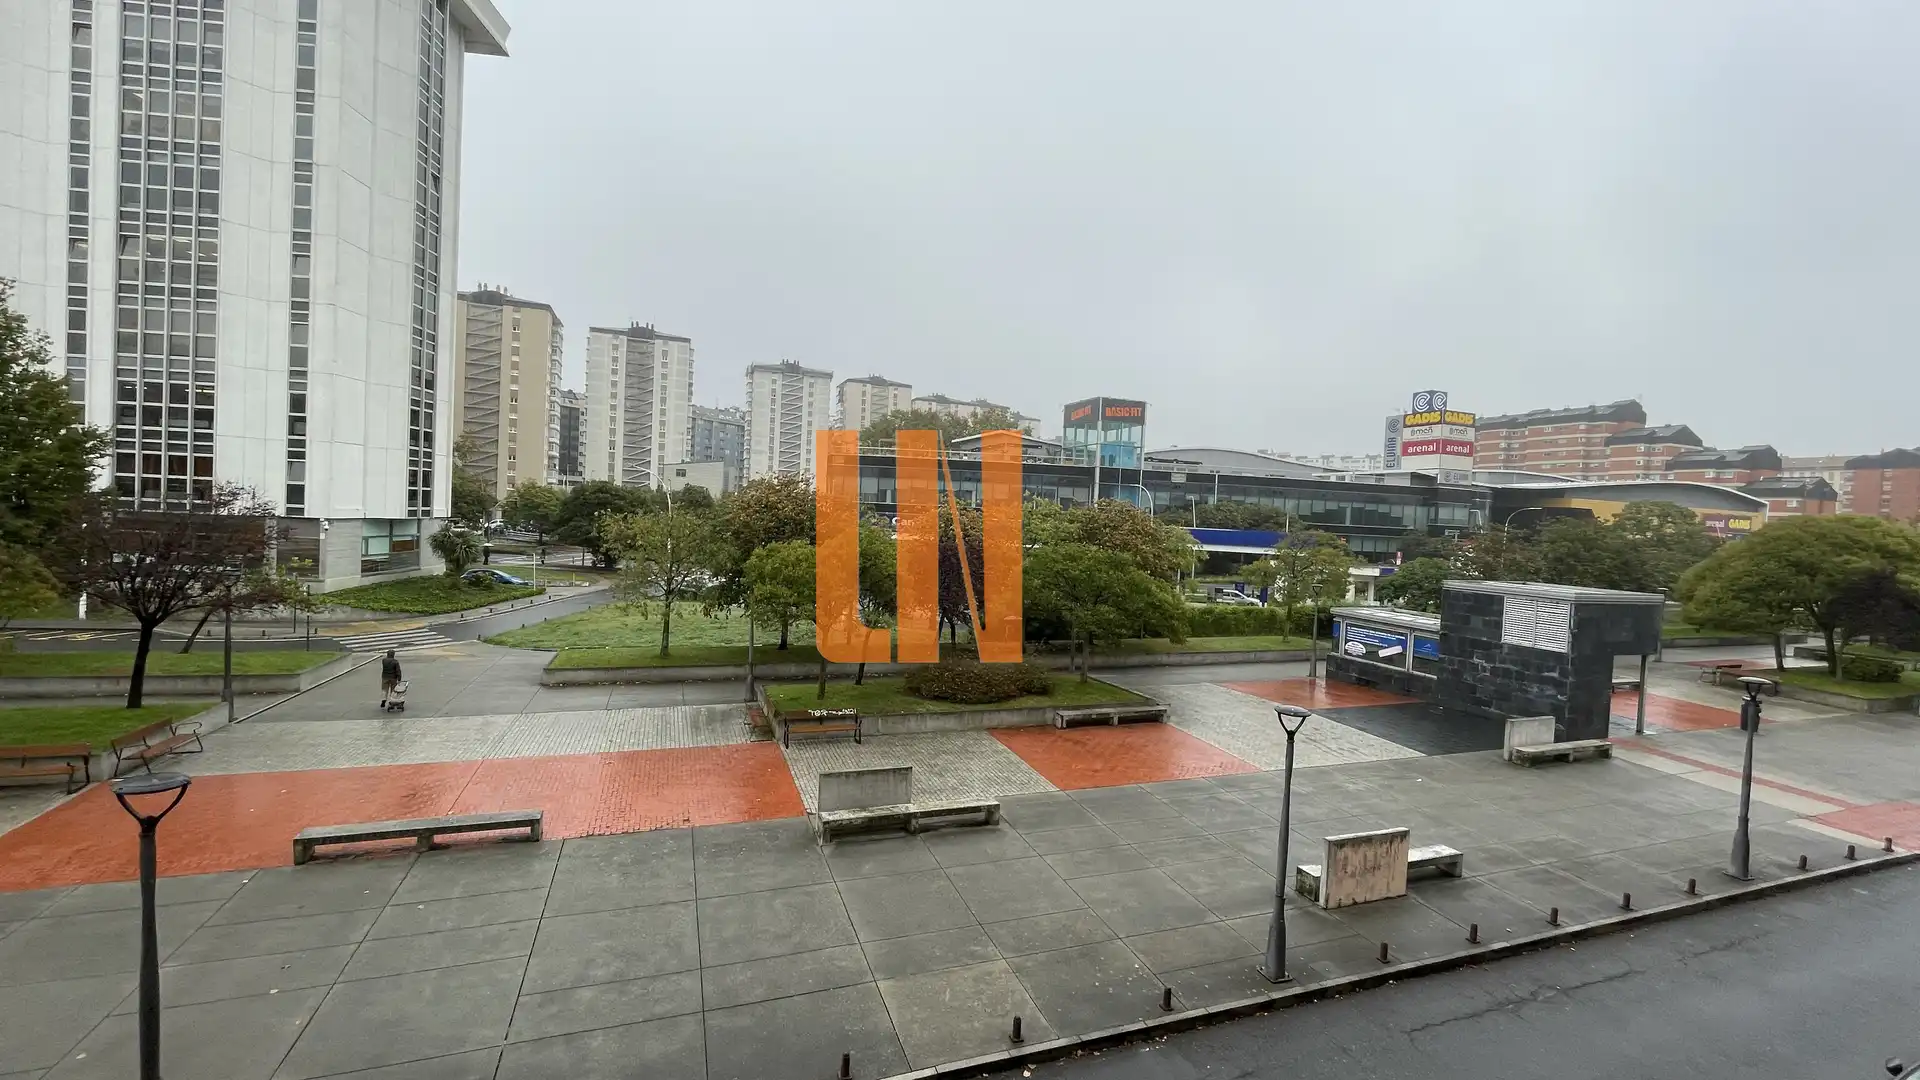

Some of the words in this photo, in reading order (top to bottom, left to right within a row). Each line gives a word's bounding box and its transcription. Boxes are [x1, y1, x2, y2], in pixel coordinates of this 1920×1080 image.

[1405, 411, 1441, 425] GADIS
[1444, 411, 1474, 425] GADIS
[1407, 442, 1437, 453] arenal
[1446, 444, 1470, 454] arenal
